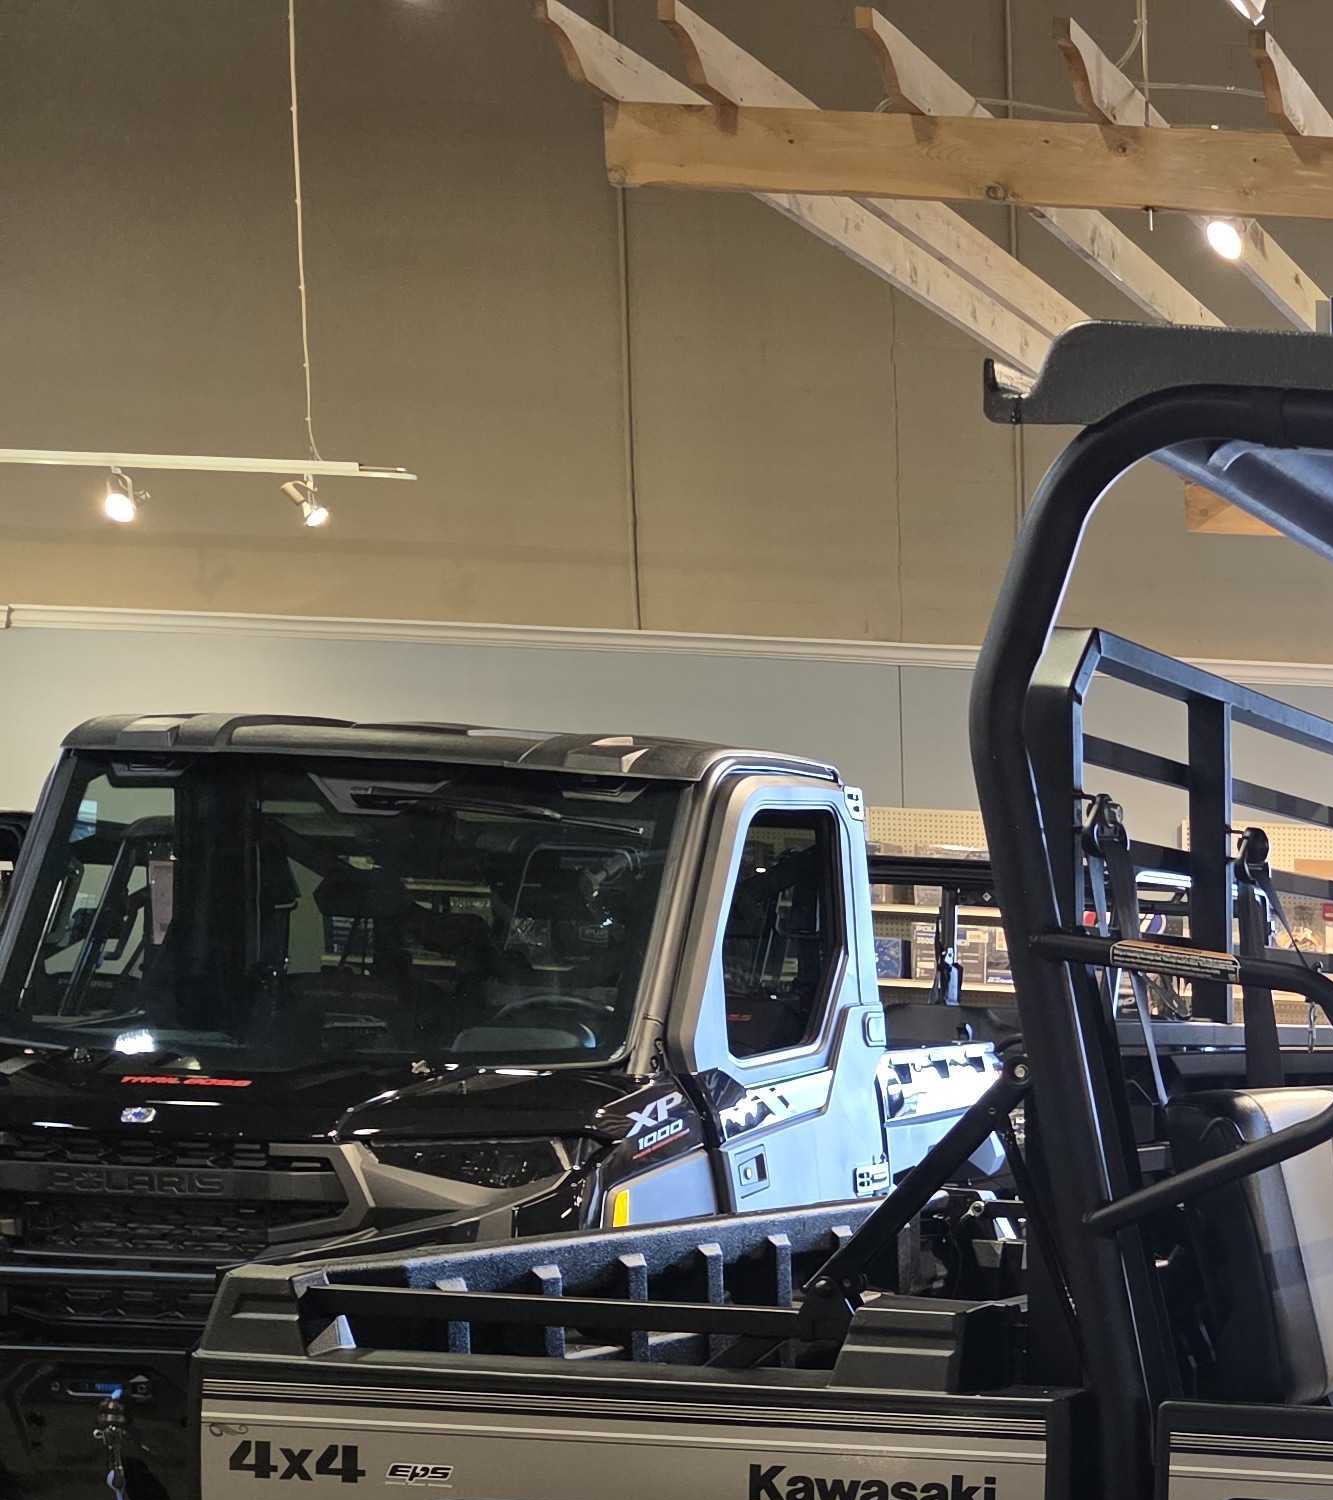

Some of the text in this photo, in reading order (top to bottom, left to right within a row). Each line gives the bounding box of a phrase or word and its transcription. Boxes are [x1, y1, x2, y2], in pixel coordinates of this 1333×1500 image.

[625, 1091, 683, 1138] XP
[638, 1118, 683, 1151] 1000
[48, 1170, 224, 1196] POLARIS
[229, 1439, 366, 1483] 4x4
